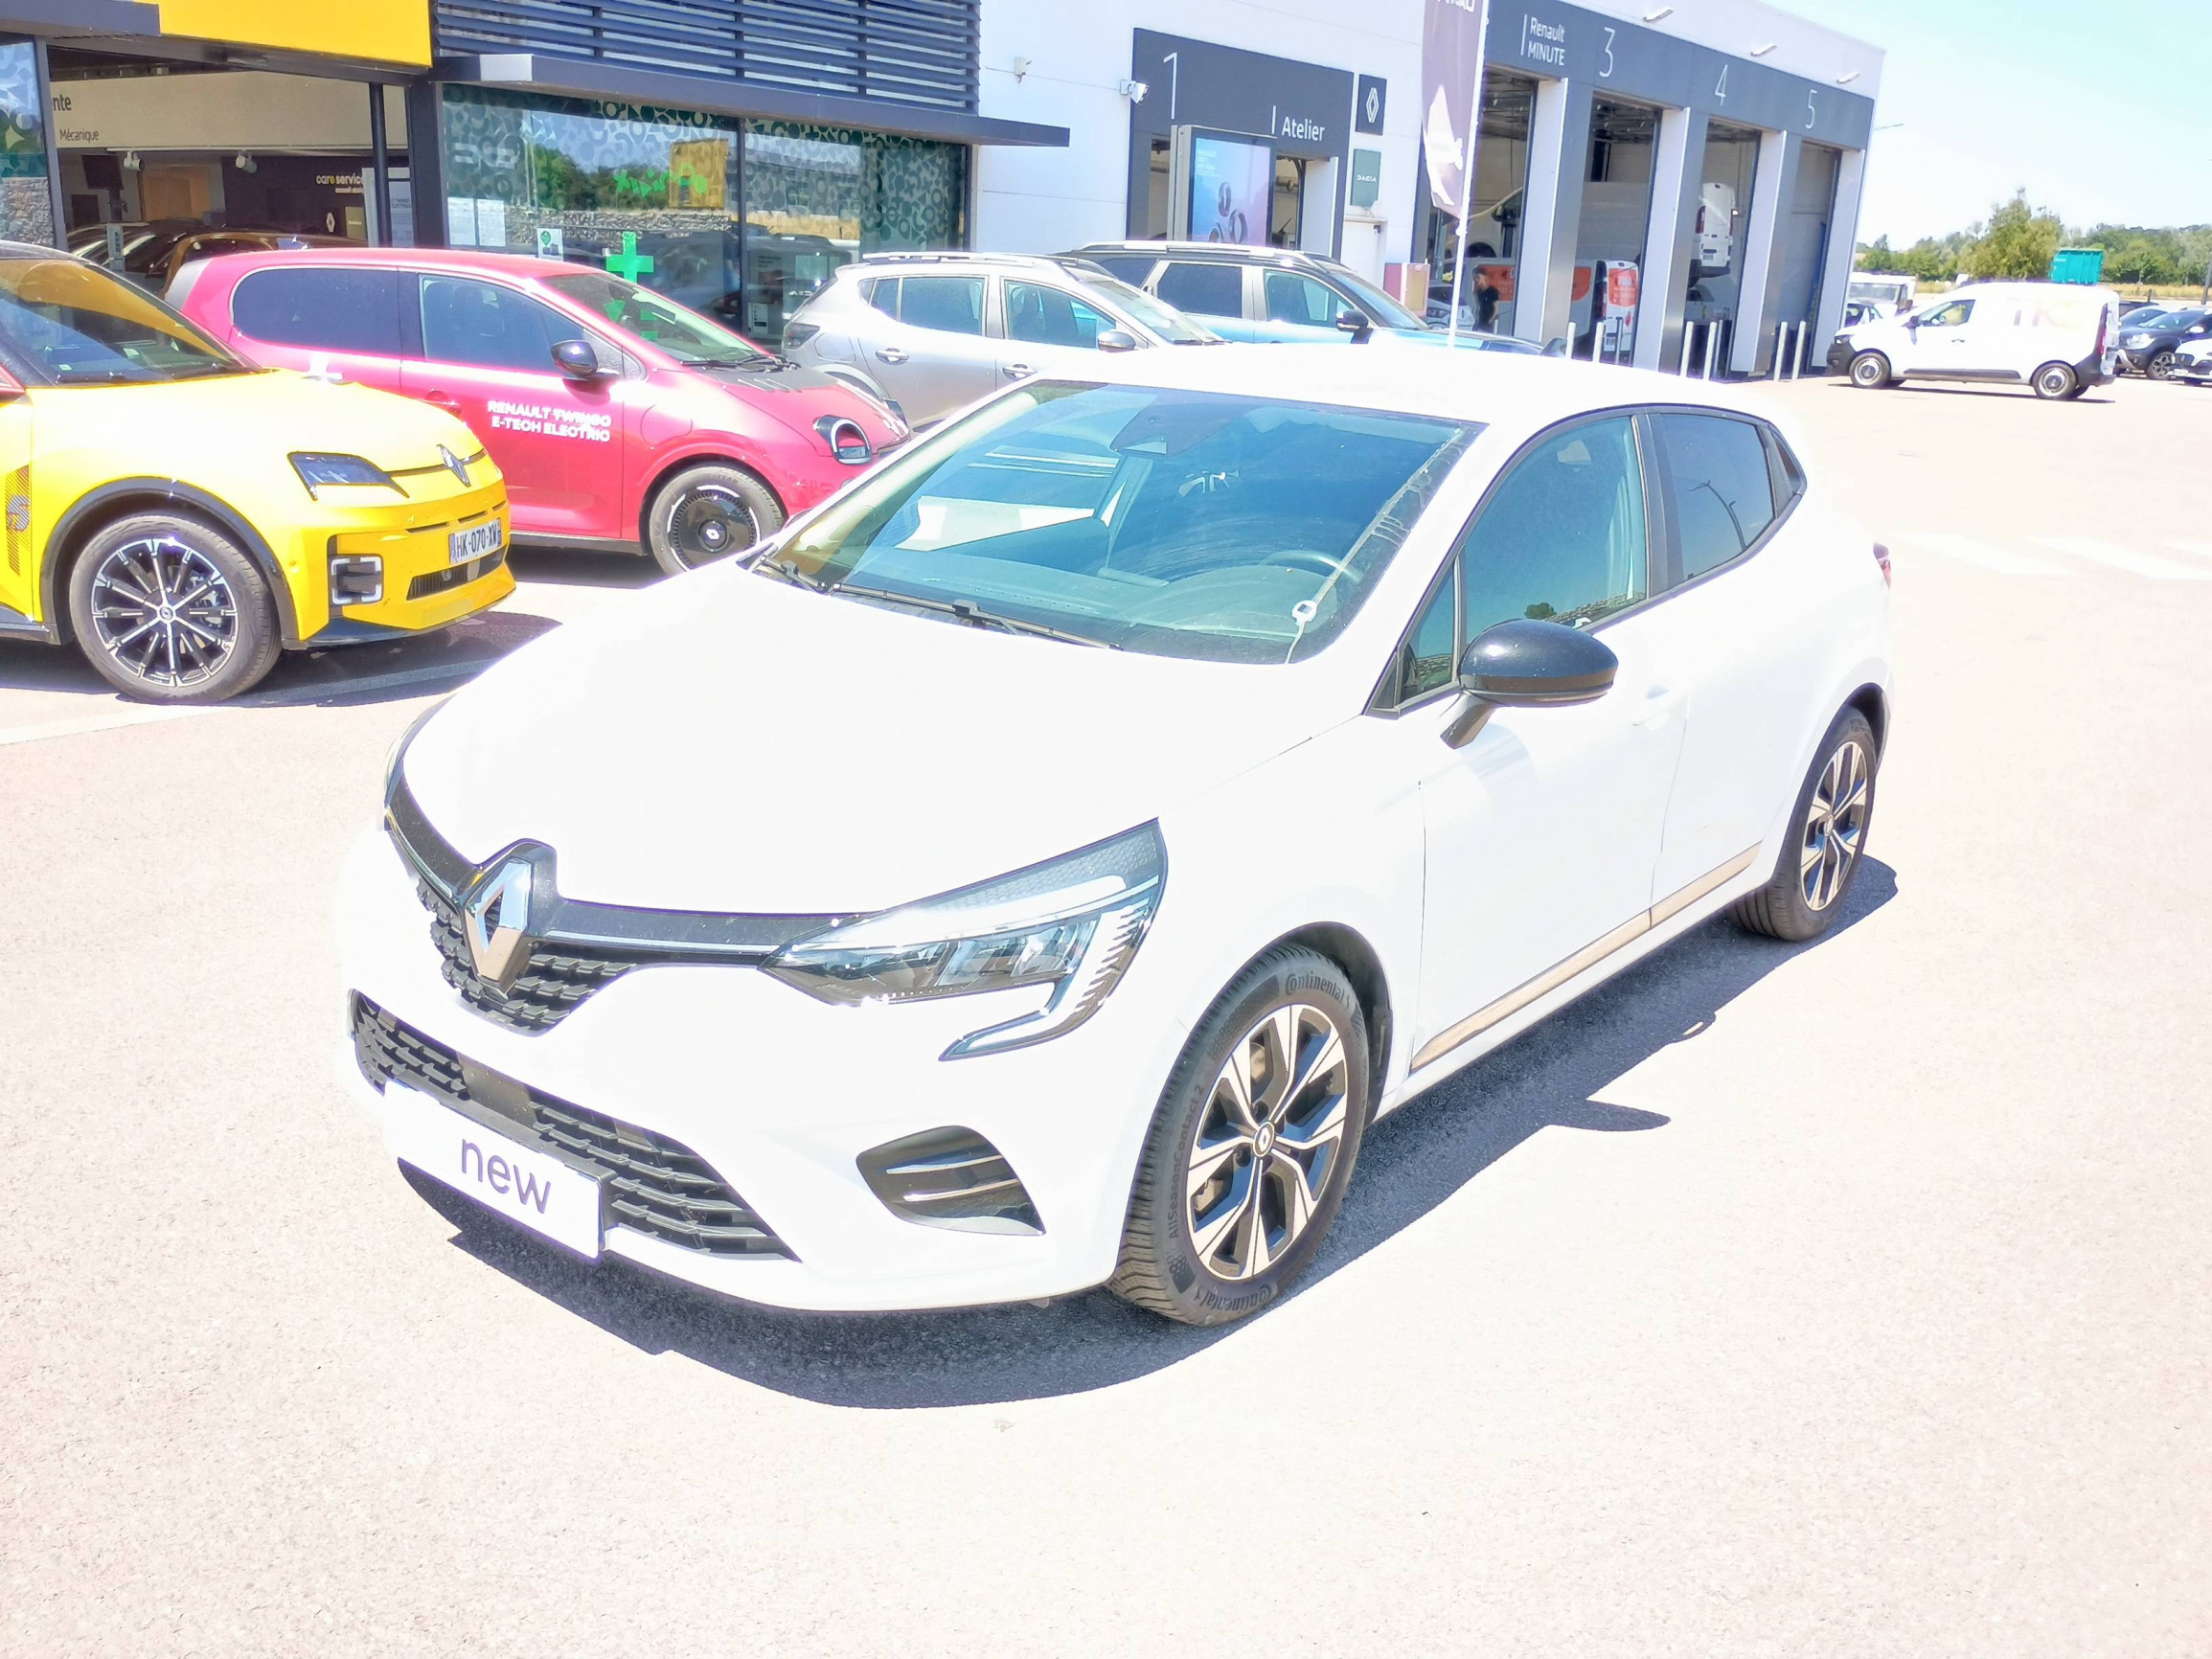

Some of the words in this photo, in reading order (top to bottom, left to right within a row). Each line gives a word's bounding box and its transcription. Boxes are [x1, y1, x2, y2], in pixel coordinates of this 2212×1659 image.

[1529, 16, 1564, 43] Renault
[1527, 40, 1565, 66] MINUTE
[1599, 27, 1615, 78] 3
[1163, 52, 1177, 120] 1
[1715, 64, 1728, 106] 4
[52, 94, 72, 111] nte
[1805, 89, 1817, 129] 5
[59, 128, 100, 143] Mécanique
[1282, 116, 1325, 142] Atelier
[316, 174, 335, 185] care
[488, 400, 552, 420] RENAULT
[1285, 970, 1346, 1003] Continental
[1168, 1100, 1198, 1239] AllSeasonContact
[1197, 1083, 1204, 1094] 2
[462, 1138, 552, 1215] new
